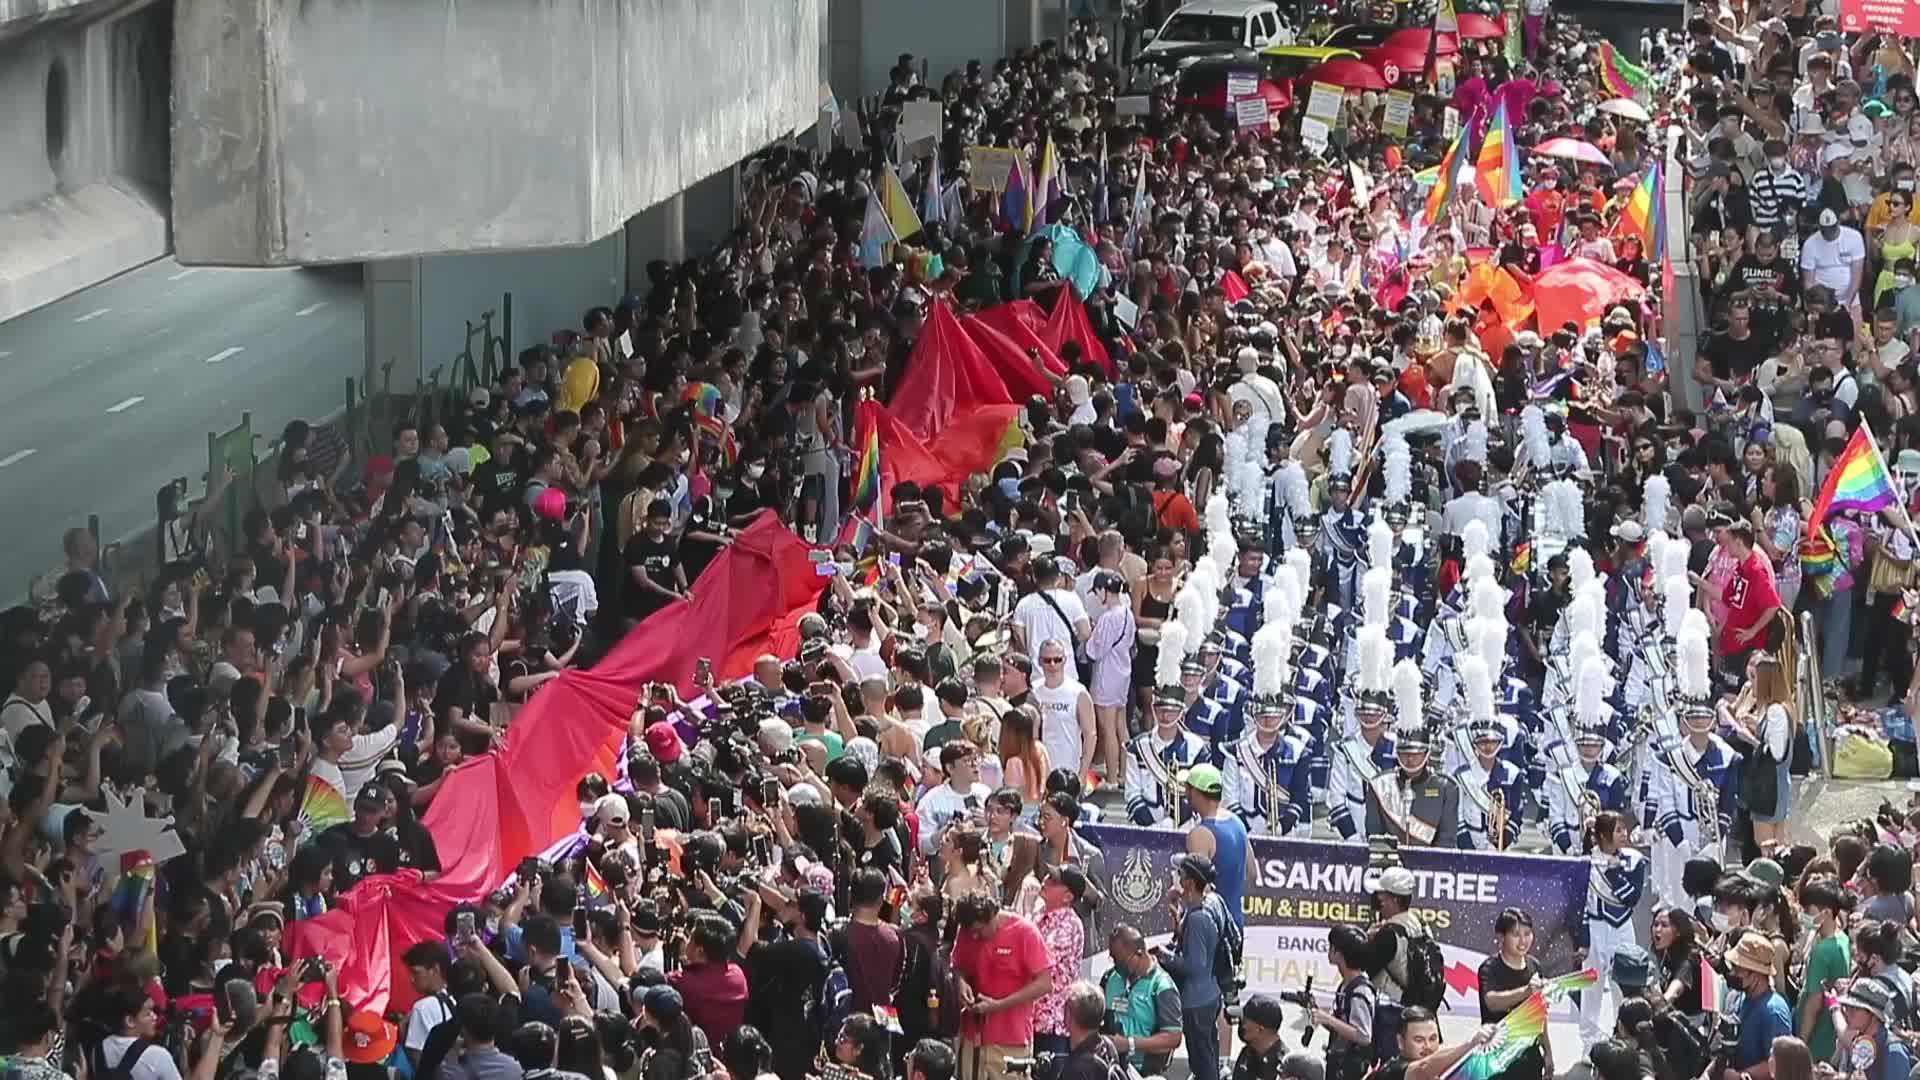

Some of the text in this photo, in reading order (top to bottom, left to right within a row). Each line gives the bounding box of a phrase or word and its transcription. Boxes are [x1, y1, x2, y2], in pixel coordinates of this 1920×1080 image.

[1240, 896, 1272, 916] UM
[1277, 898, 1293, 918] &
[1299, 900, 1370, 922] BUGLE
[1277, 935, 1328, 953] BANG
[1243, 954, 1343, 987] THAIL
